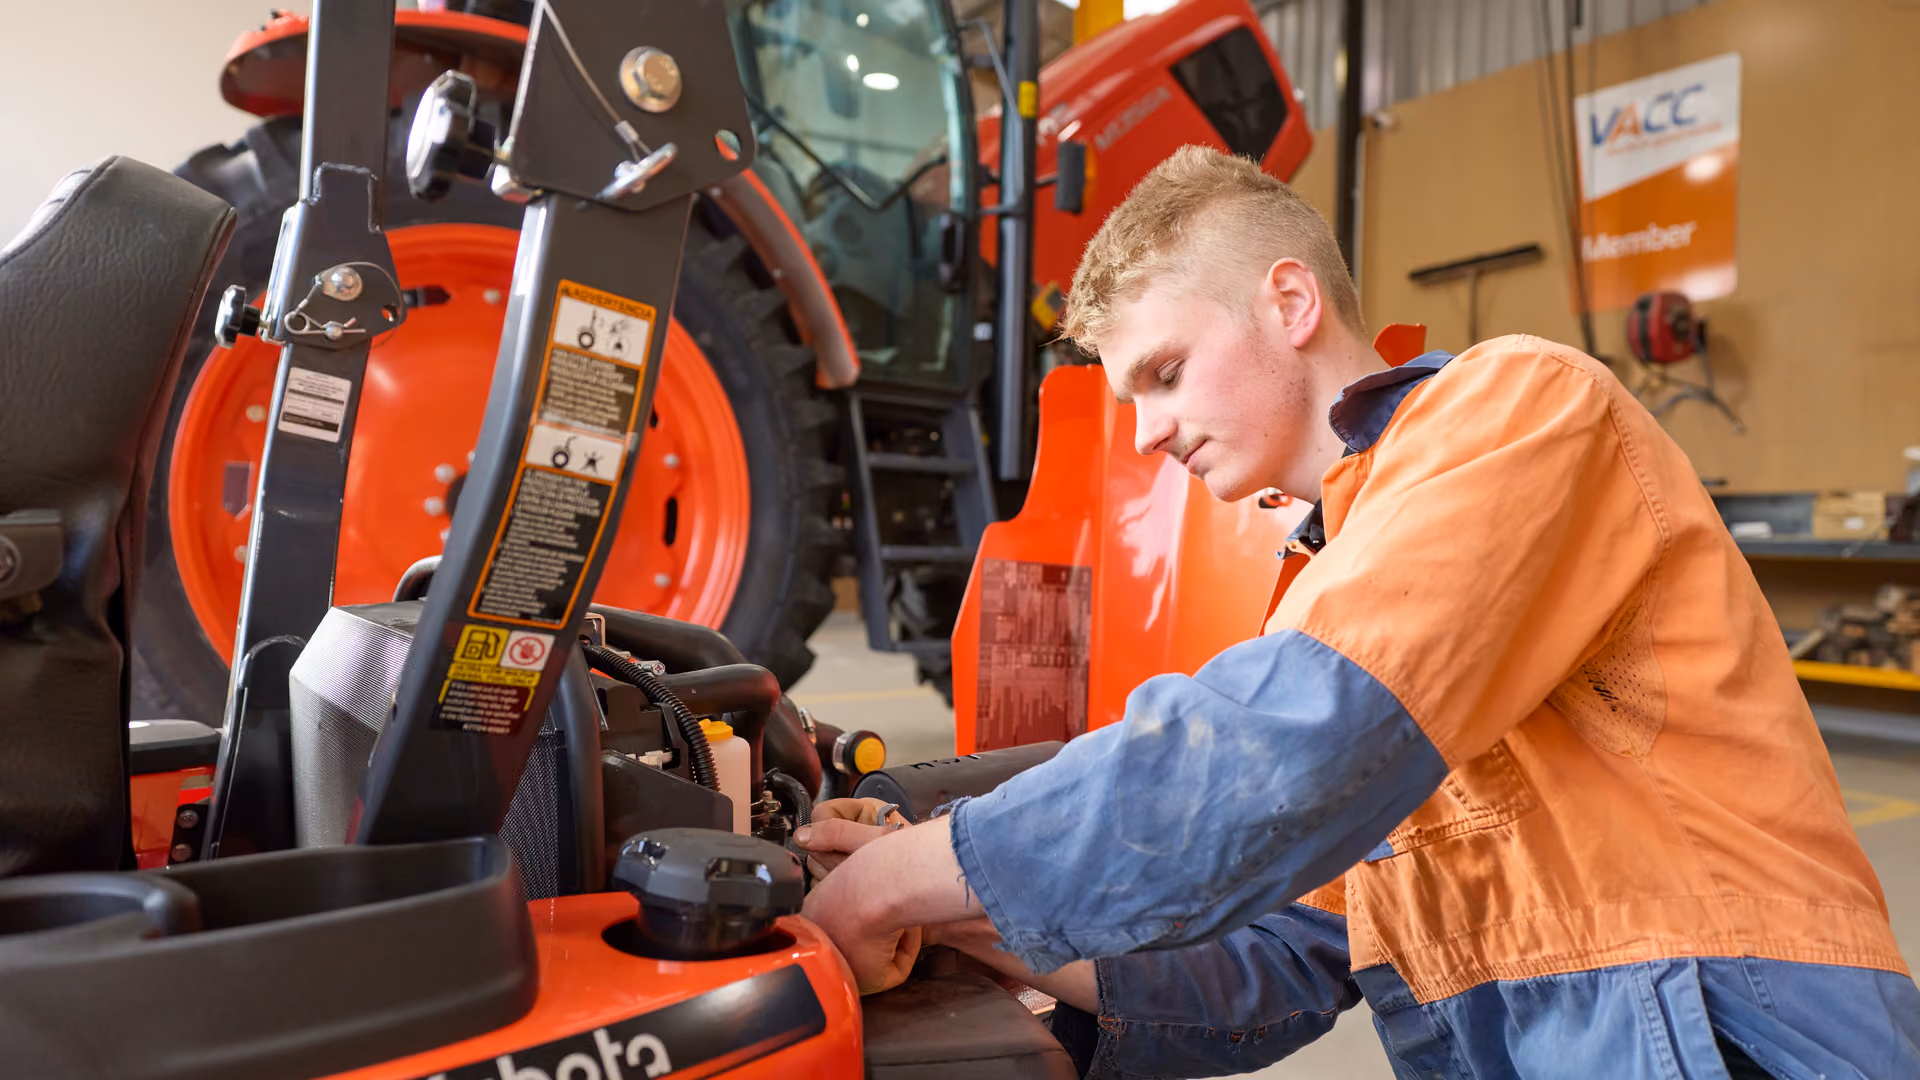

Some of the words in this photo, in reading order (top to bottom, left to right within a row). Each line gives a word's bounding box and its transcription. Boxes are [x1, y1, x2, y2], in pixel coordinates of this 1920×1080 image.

[1590, 82, 1703, 147] VACC
[1582, 221, 1697, 261] Member
[572, 287, 653, 318] ADVERTENCIA
